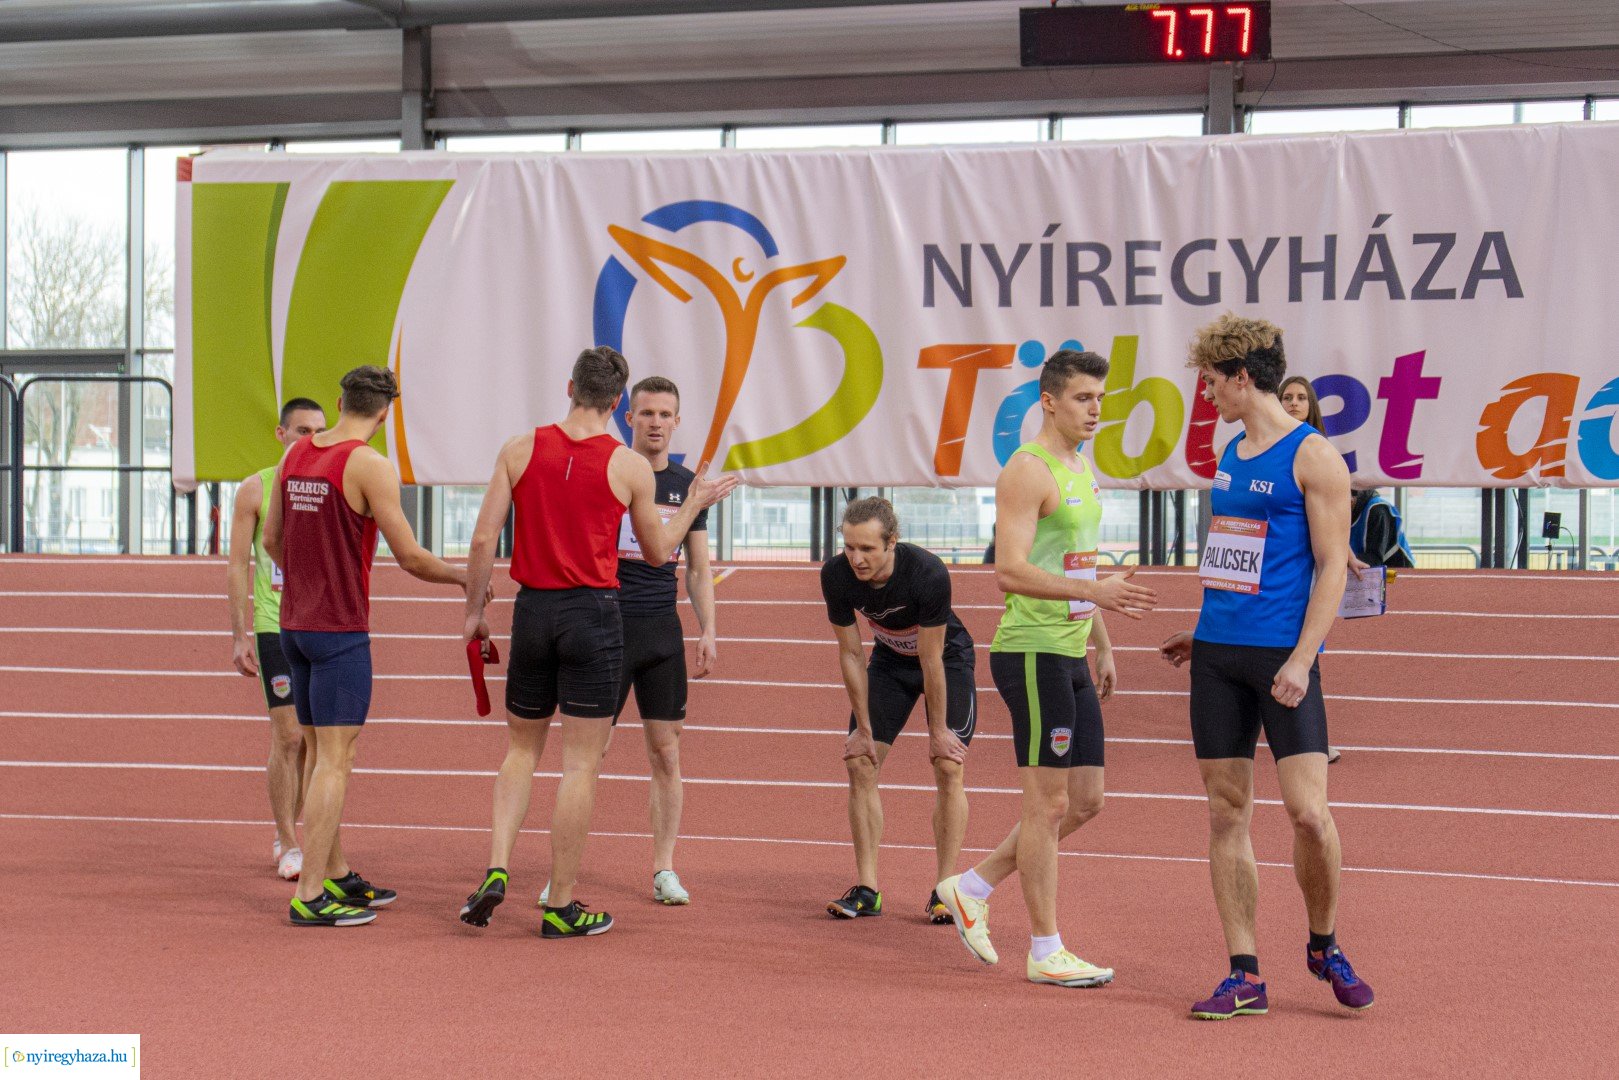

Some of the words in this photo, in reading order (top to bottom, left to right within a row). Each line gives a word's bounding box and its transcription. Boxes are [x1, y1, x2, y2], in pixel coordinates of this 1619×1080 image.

[1152, 8, 1250, 56] 7.77
[922, 214, 1524, 308] NYÍREGYHÁZA
[287, 480, 329, 495] IKARUS
[1249, 479, 1275, 495] KSI
[1203, 546, 1260, 574] PALICSEK
